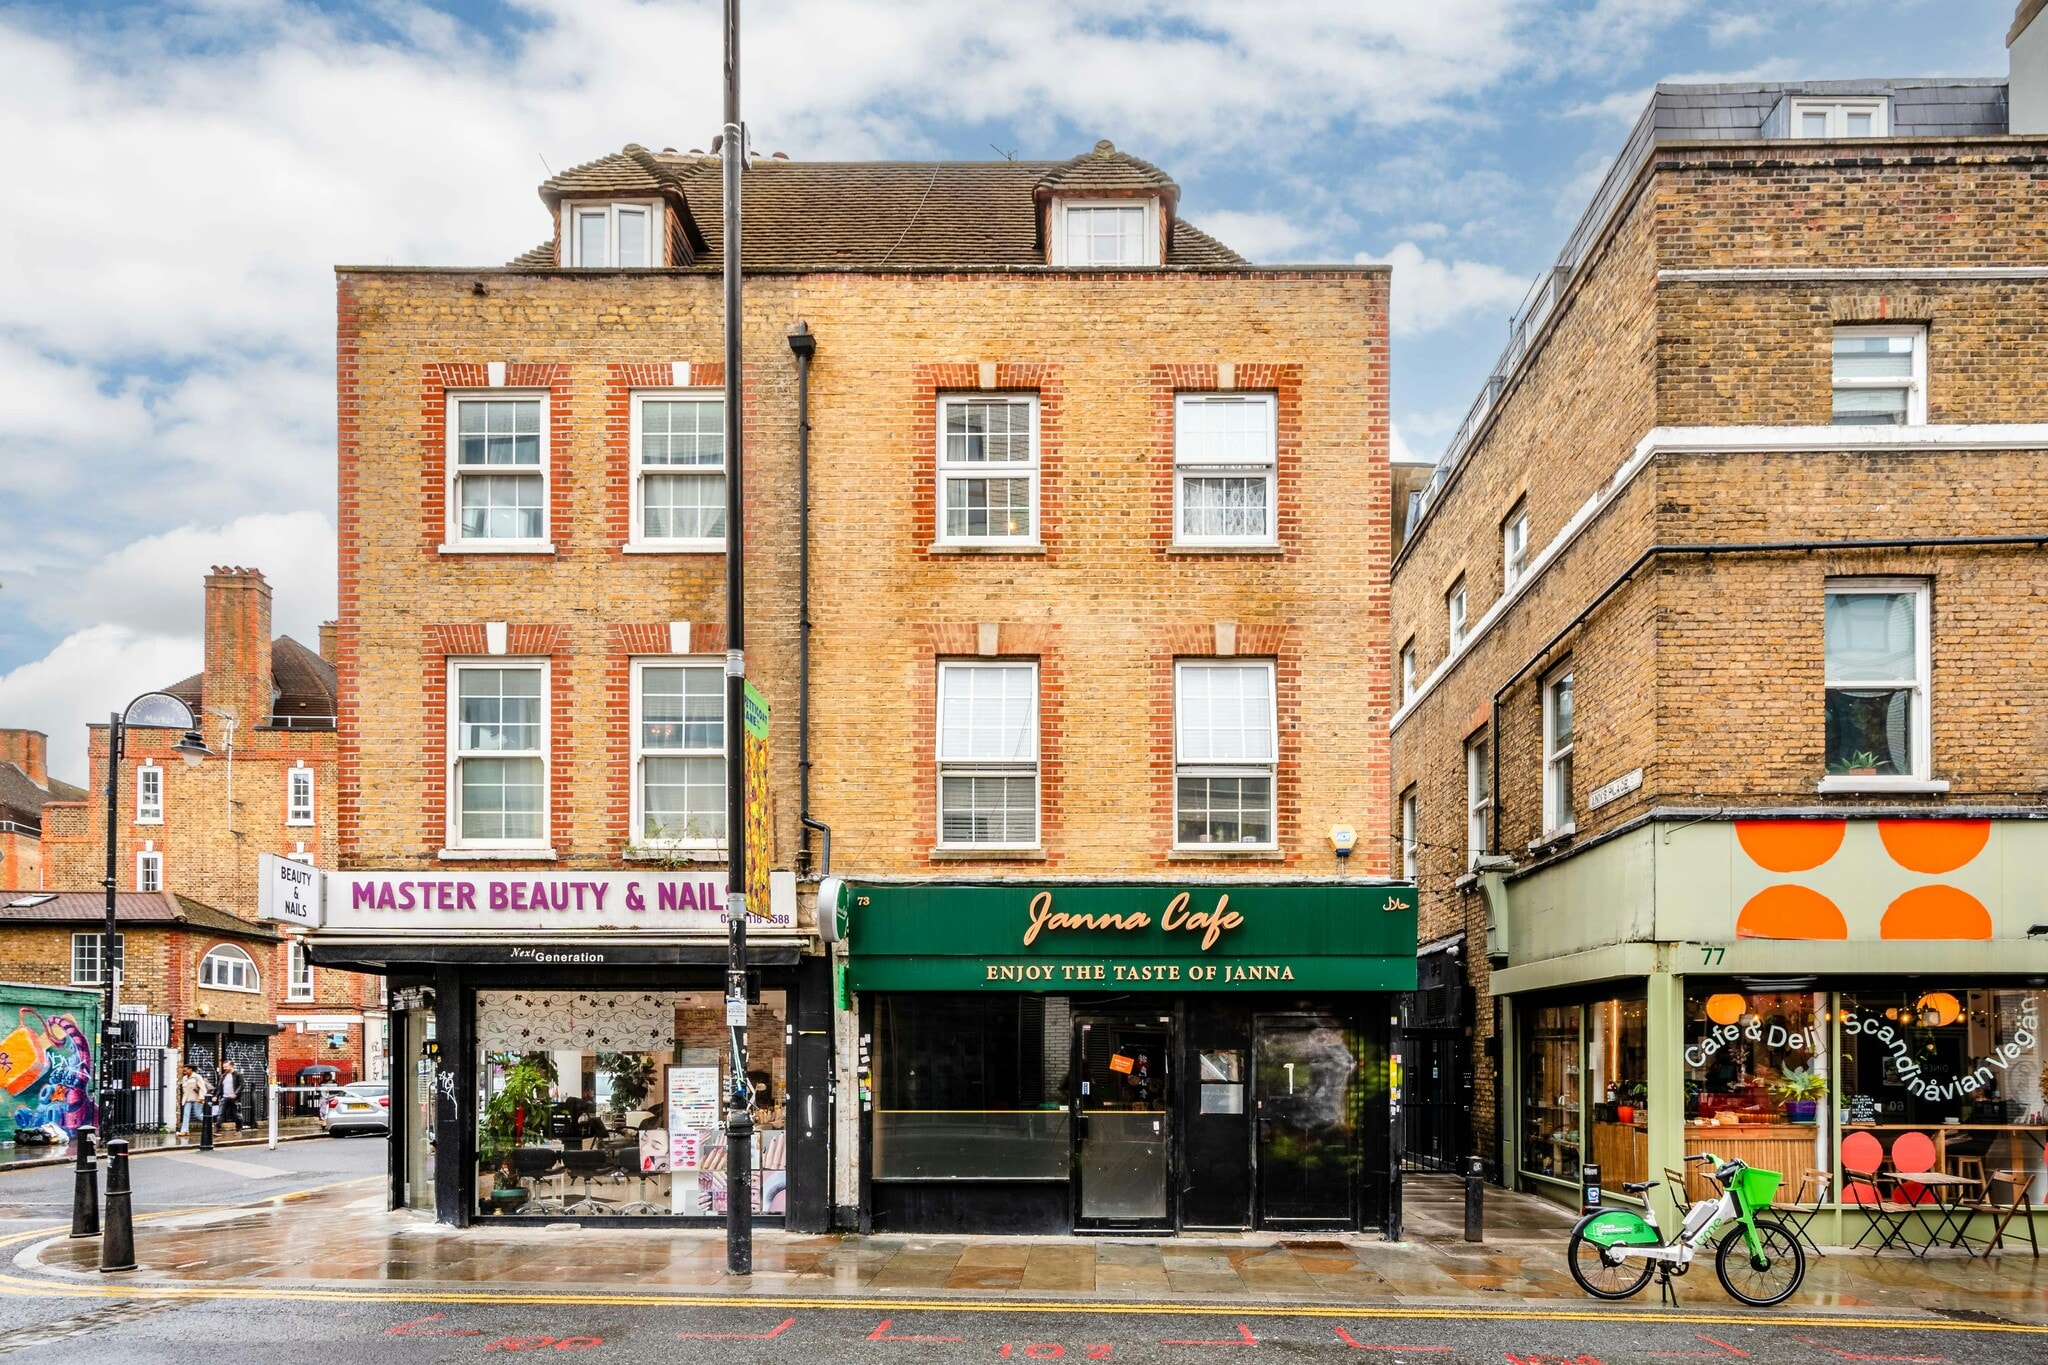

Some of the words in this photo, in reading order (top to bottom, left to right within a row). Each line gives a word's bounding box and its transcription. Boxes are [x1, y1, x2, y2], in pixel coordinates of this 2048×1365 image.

[144, 714, 175, 724] Market
[281, 866, 311, 886] BEAUTY
[293, 886, 299, 899] &
[352, 881, 477, 910] MASTER
[489, 881, 609, 911] BEAUTY
[625, 881, 646, 911] &
[857, 896, 870, 906] 73
[285, 900, 307, 917] NAILS
[1382, 896, 1410, 911] حلال
[1023, 891, 1151, 946] Janna
[1161, 892, 1244, 951] Cafe
[510, 947, 536, 958] Next
[535, 951, 604, 963] Generation
[1700, 947, 1726, 966] 77
[986, 965, 1055, 982] ENJOY
[1061, 965, 1106, 980] THE
[1113, 965, 1181, 980] TASTE
[1188, 965, 1217, 980] OF
[1224, 965, 1295, 982] JANNA
[1684, 1021, 1740, 1069] Cafe
[1745, 1018, 1763, 1042] &
[1767, 1024, 1818, 1051] Deli
[1842, 1013, 1994, 1102] Scandinåvian
[1985, 996, 2040, 1072] Vegän
[1694, 1217, 1722, 1247] Lime
[999, 1342, 1113, 1359] 102
